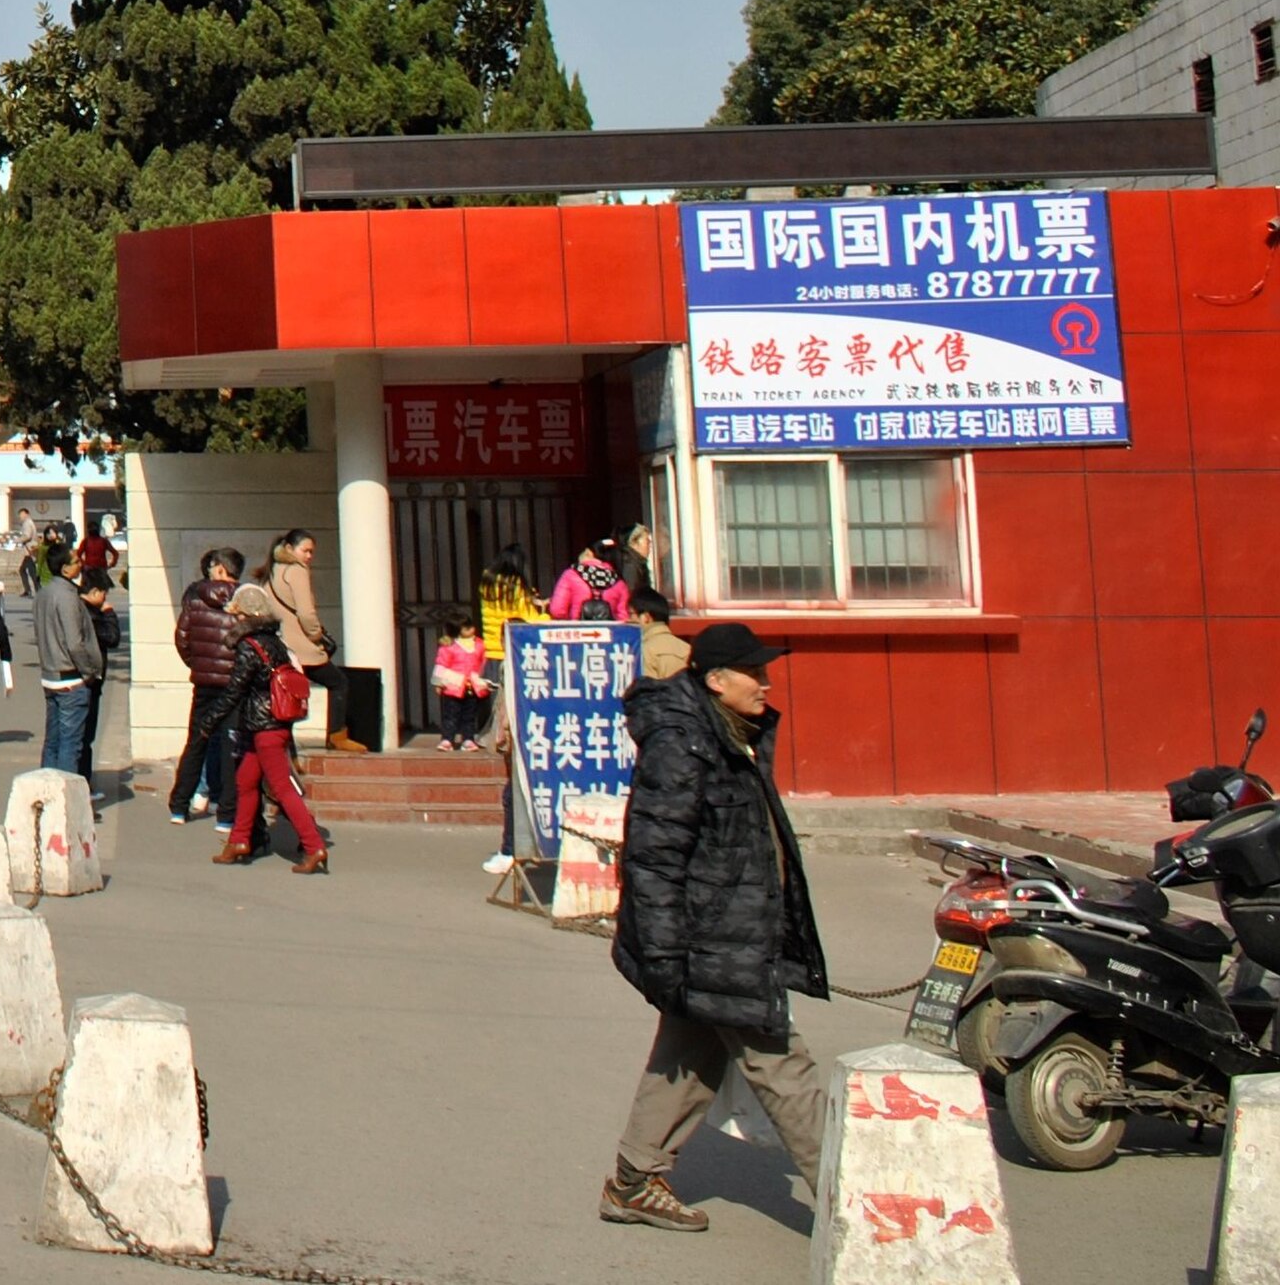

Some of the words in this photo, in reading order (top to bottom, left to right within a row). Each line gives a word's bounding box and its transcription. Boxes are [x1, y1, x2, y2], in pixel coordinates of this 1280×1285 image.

[696, 197, 1097, 272] 国际国内机票
[927, 267, 1101, 299] 87877777
[698, 331, 972, 379] 铁路客票代售
[702, 391, 743, 402] TRAIN
[754, 389, 802, 401] TICKET
[813, 388, 866, 400] AGENCY
[453, 398, 575, 465] 汽车票
[705, 412, 835, 443] 宏基汽车站
[854, 406, 1117, 441] 付家坡汽车站联网售票
[520, 642, 635, 701] 禁止停放
